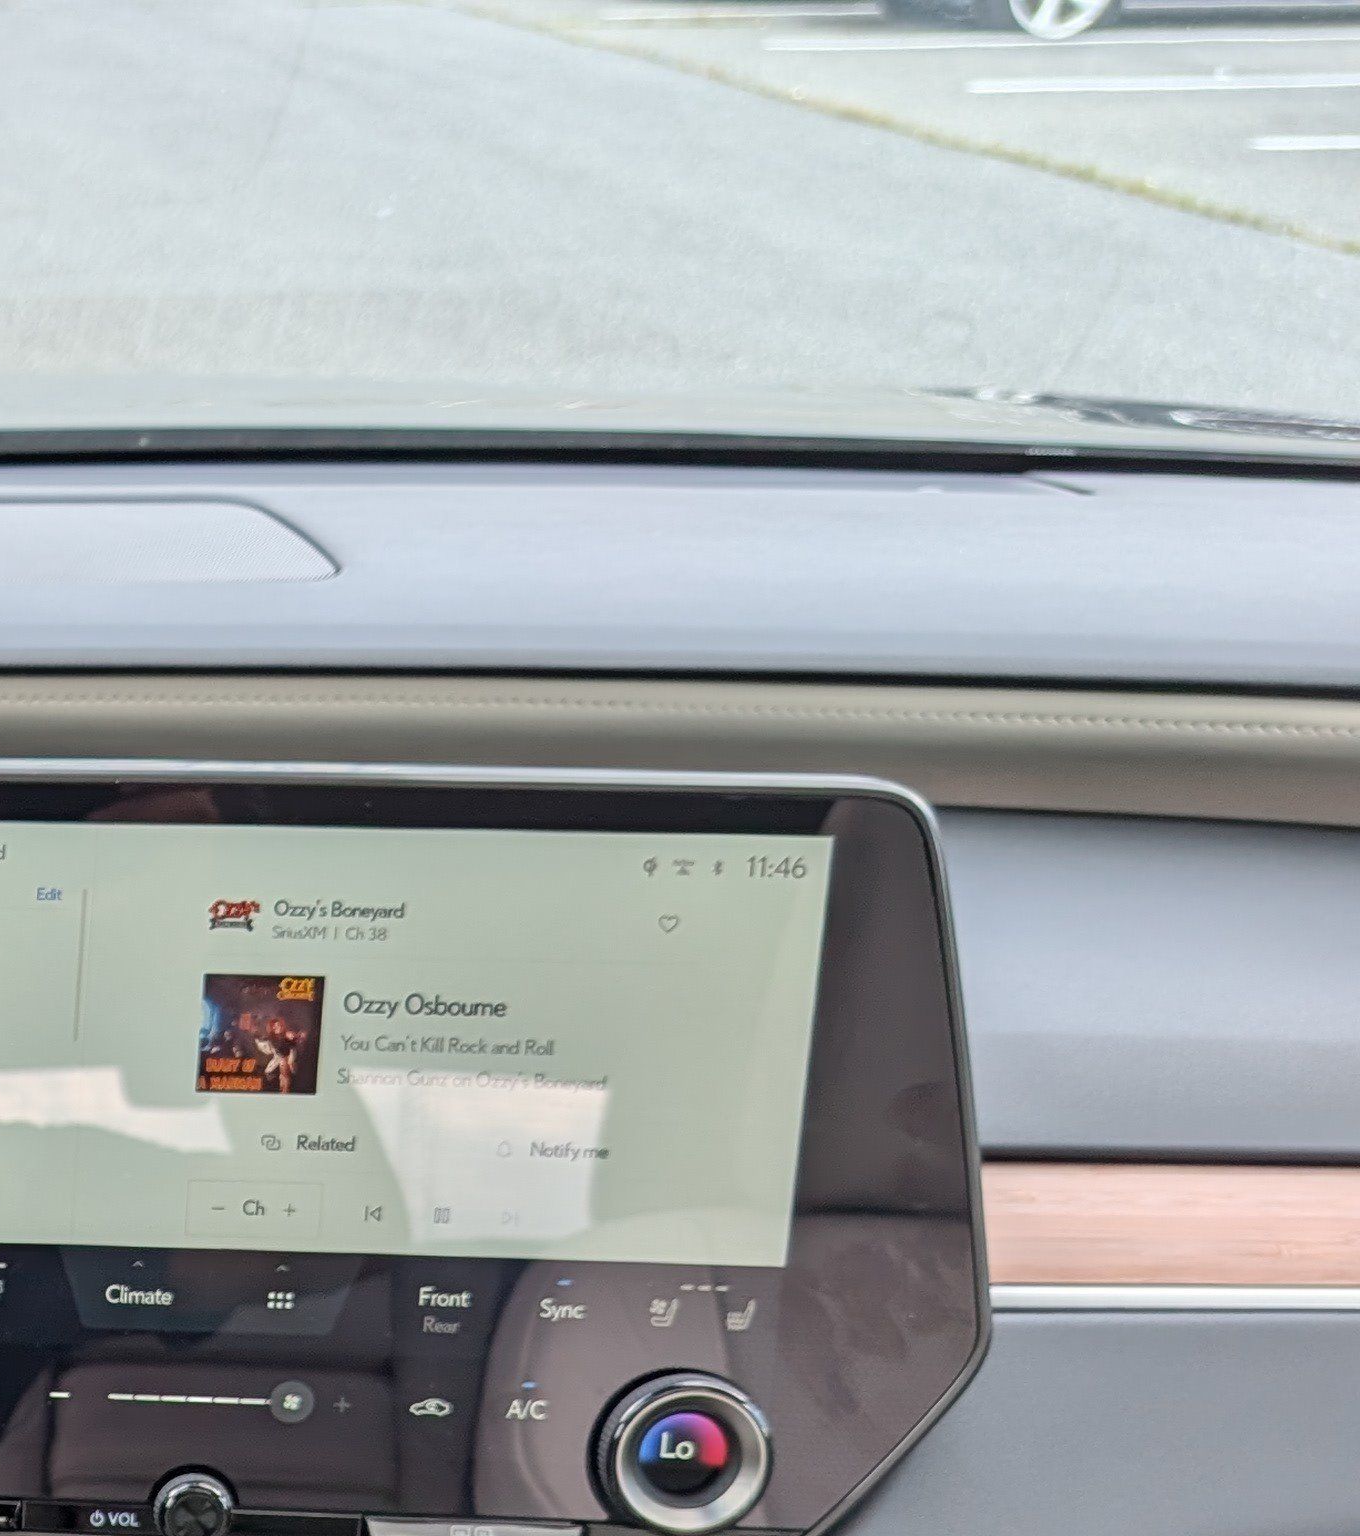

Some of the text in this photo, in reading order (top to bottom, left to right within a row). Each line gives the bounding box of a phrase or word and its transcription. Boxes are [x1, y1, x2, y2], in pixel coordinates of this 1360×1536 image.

[746, 855, 807, 879] 11:46
[36, 887, 63, 902] Edit
[273, 899, 406, 920] Ozzy's Boneyard
[272, 926, 388, 942] SiriusXM Ch 38
[343, 991, 508, 1018] Ozzy Osbourne
[341, 1034, 555, 1056] You Can't Kill Rock and Roll
[295, 1134, 610, 1161] Related Notify me
[242, 1199, 266, 1217] Ch
[105, 1284, 174, 1307] Climate
[418, 1287, 472, 1309] Front
[539, 1299, 586, 1323] Sync
[422, 1316, 460, 1335] Rear
[505, 1399, 548, 1421] A/C
[659, 1431, 697, 1461] Lo
[108, 1511, 140, 1528] VOL
